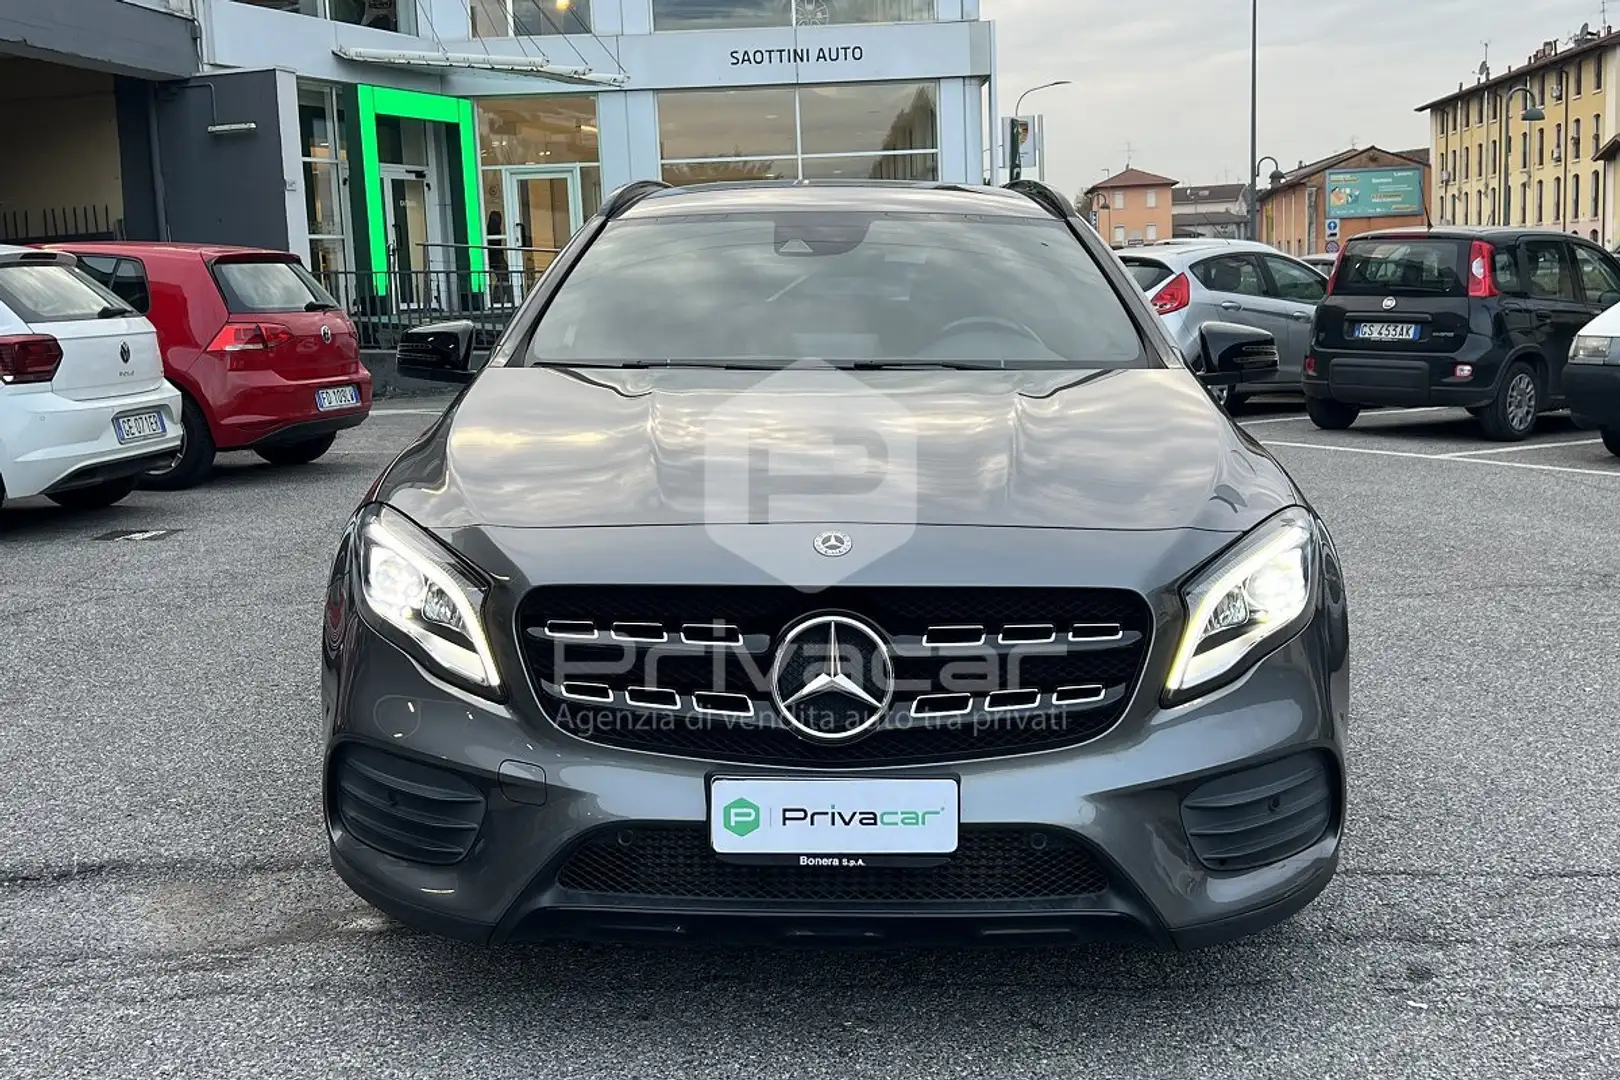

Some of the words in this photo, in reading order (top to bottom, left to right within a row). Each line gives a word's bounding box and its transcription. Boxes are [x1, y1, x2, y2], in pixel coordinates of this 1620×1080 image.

[730, 48, 810, 65] SAOTTINI
[816, 46, 863, 62] AUTO
[1377, 324, 1413, 337] 453AK
[782, 804, 941, 827] Privacar
[799, 855, 840, 866] Bonera
